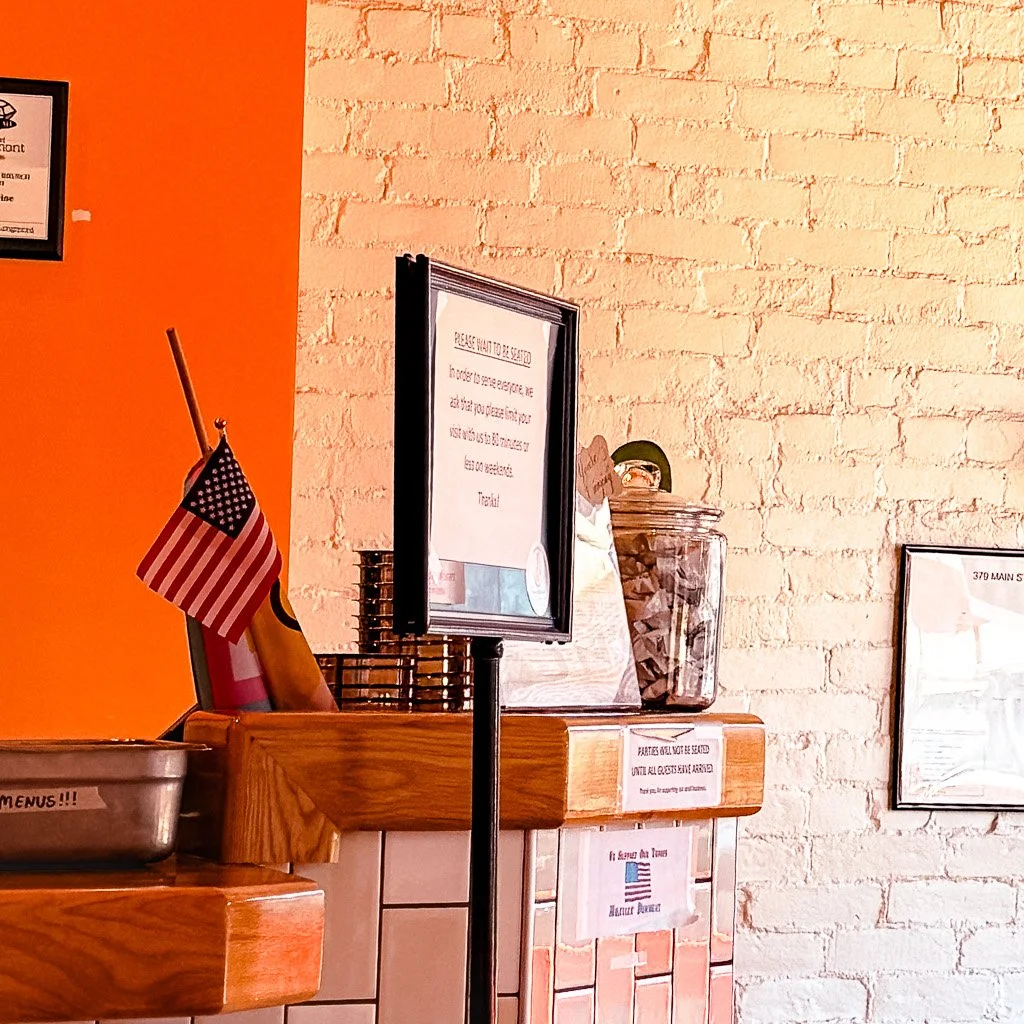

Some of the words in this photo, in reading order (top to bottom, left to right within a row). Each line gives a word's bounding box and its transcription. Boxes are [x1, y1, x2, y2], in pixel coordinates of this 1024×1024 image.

[454, 331, 476, 350] PLEASE
[477, 338, 492, 354] WAIT
[493, 341, 502, 356] TO
[503, 344, 510, 359] BE
[511, 347, 532, 365] SEATED
[449, 364, 456, 378] In
[456, 367, 473, 382] order
[474, 372, 481, 385] to
[449, 394, 460, 409] ask
[460, 396, 473, 412] that
[474, 403, 485, 416] you
[486, 402, 504, 419] please
[505, 406, 518, 422] limit
[518, 412, 532, 426] your
[476, 432, 484, 444] us
[500, 435, 522, 451] minutes
[475, 461, 484, 472] on
[477, 491, 499, 508] Thanks!
[991, 572, 1014, 581] MAIN
[637, 745, 659, 756] PARTIES
[660, 745, 672, 756] WILL
[672, 745, 683, 755] NOT
[684, 745, 691, 755] BE
[691, 744, 710, 755] SEATED
[631, 766, 647, 776] UNTIL
[648, 765, 656, 776] ALL
[657, 764, 677, 775] GUESTS
[677, 763, 691, 774] HAVE
[0, 791, 77, 810] MENUS!!!
